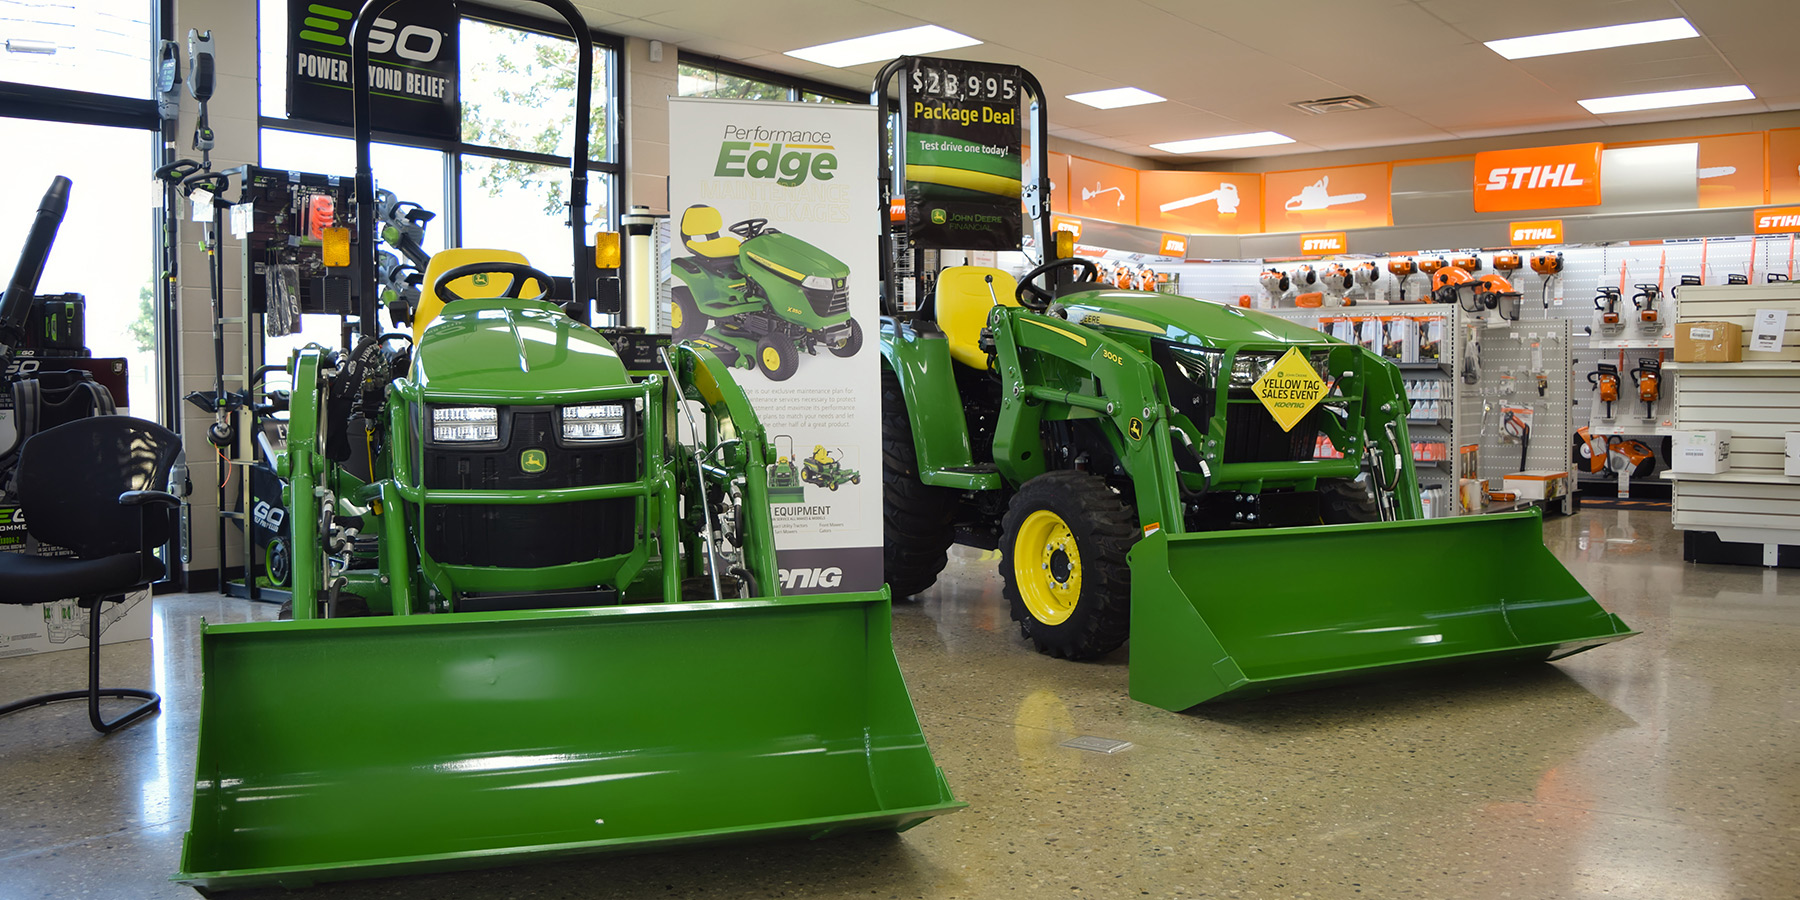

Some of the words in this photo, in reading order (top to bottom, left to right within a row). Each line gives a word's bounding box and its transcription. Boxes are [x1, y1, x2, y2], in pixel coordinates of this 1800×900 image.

[298, 53, 348, 83] POWER
[368, 66, 402, 92] YOND
[406, 72, 445, 98] BELIEF
[914, 102, 978, 126] Package
[982, 106, 1014, 125] Deal
[724, 124, 832, 144] Performance
[920, 140, 939, 150] Test
[940, 141, 963, 152] drive
[964, 144, 980, 153] one
[982, 145, 1008, 158] today!
[714, 141, 838, 188] Edge
[1485, 164, 1584, 190] STIHL
[700, 180, 850, 204] MAINTENANCE
[750, 202, 850, 224] PACKAGES
[950, 213, 974, 222] JOHN
[975, 214, 1002, 223] DEERE
[950, 223, 992, 232] FINANCIAL
[1513, 228, 1556, 241] STIHL
[1166, 240, 1184, 252] STIHL
[1303, 238, 1341, 250] STIHL
[1264, 379, 1301, 389] YELLOW
[1304, 380, 1320, 390] TAG
[1262, 389, 1288, 399] SALES
[1290, 390, 1318, 400] EVENT
[774, 506, 831, 516] EQUIPMENT
